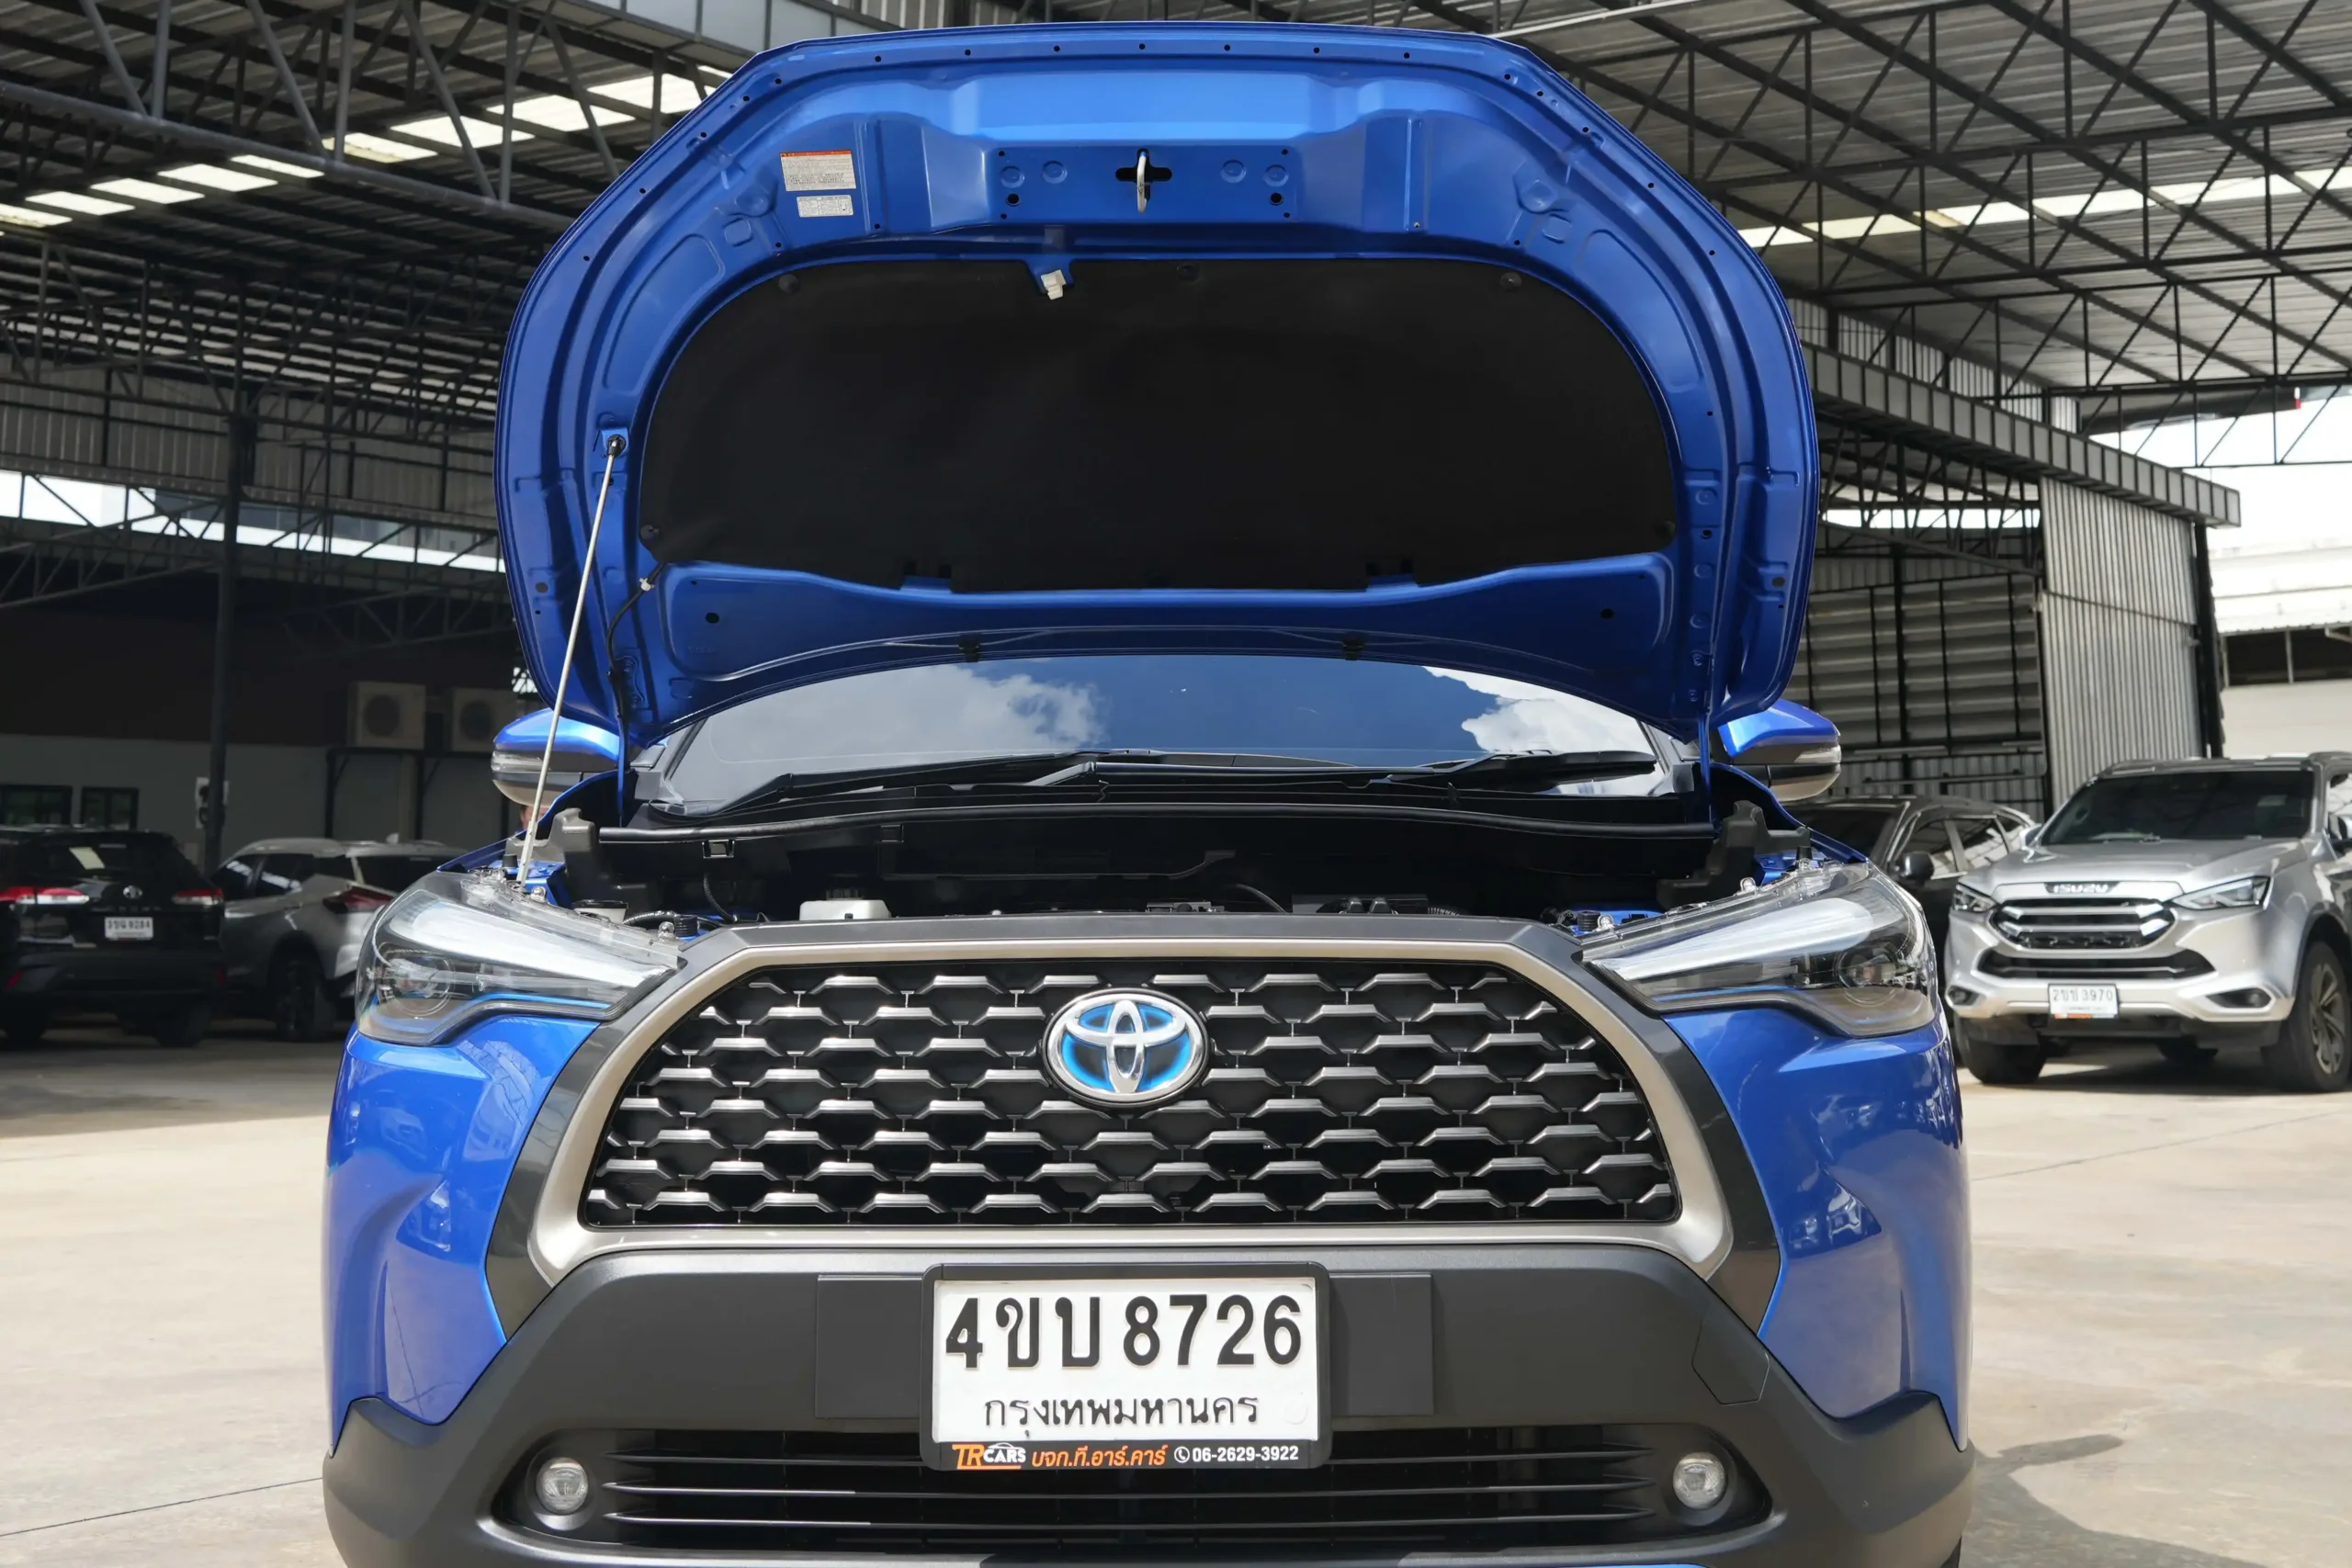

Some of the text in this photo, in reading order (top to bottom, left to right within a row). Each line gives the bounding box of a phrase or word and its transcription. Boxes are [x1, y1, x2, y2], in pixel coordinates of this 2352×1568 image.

[2053, 884, 2109, 894] ISUZU
[2082, 988, 2113, 1001] 3970
[945, 1294, 1301, 1369] 4ขบ 8726
[984, 1397, 1259, 1439] กรุงเทพมหานคร
[1192, 1445, 1299, 1462] 06-2629-3922
